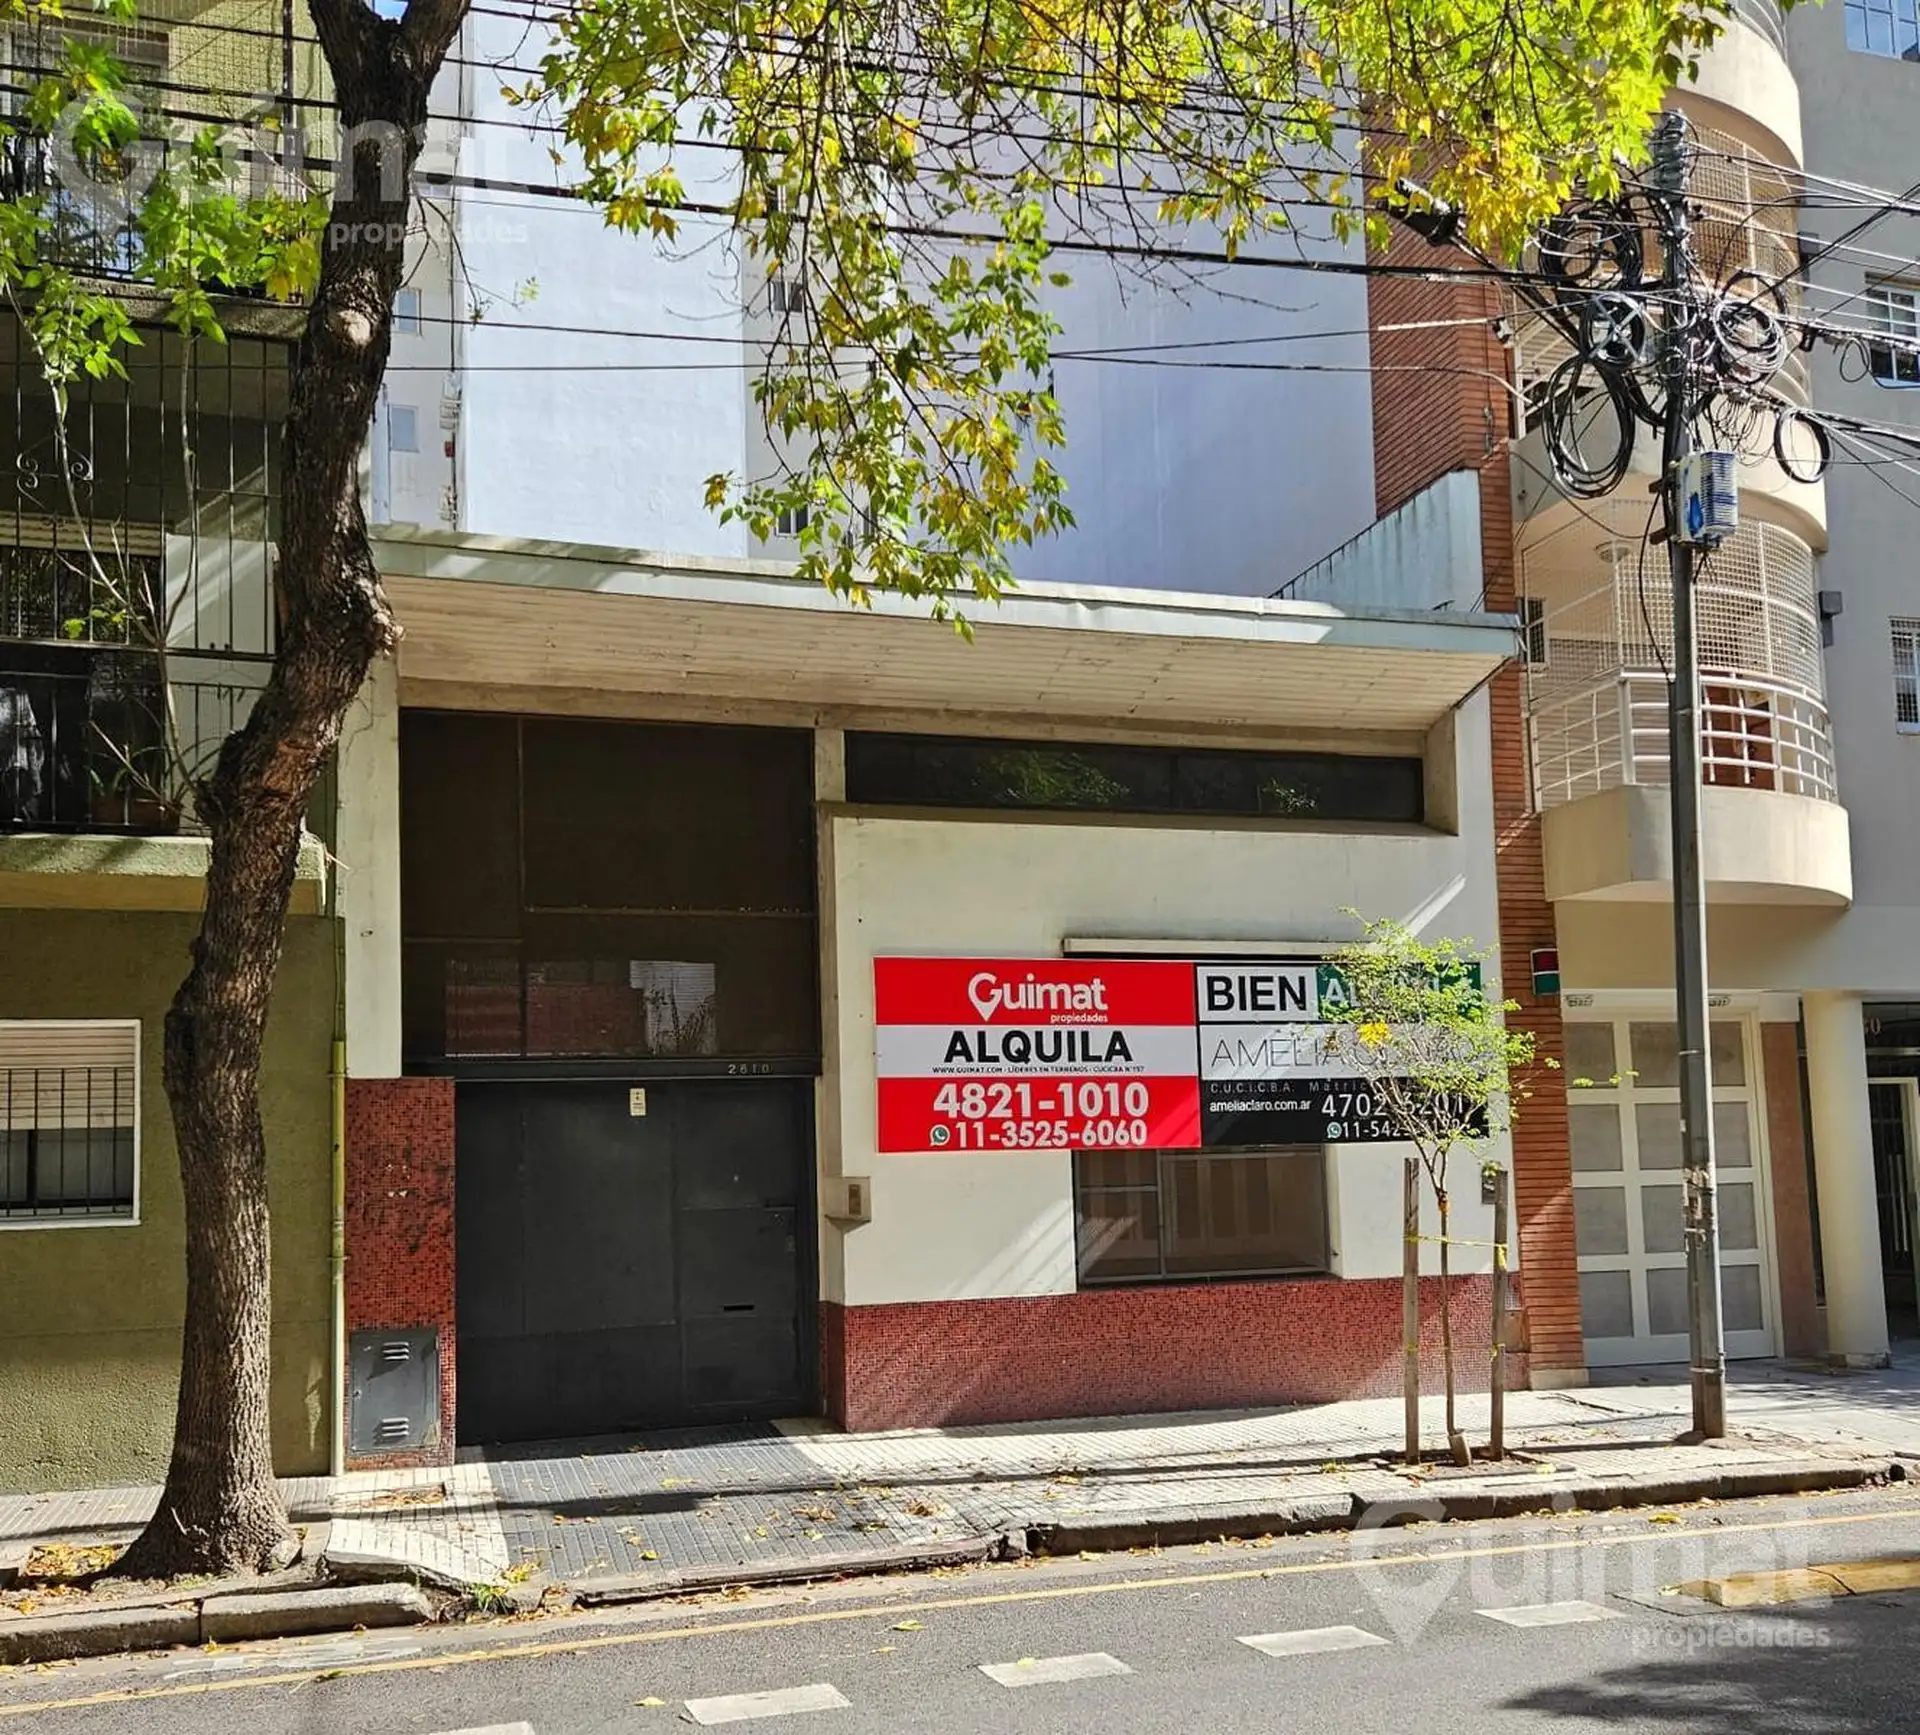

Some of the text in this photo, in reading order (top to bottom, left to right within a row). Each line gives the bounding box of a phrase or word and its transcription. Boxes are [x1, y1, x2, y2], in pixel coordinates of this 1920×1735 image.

[968, 972, 1109, 1021] Guimat
[1206, 975, 1307, 1012] BIEN
[1050, 1012, 1109, 1023] propiedades
[944, 1030, 1133, 1064] ALQUILA
[933, 1081, 1149, 1119] 4821-1010
[1209, 1099, 1312, 1113] ameliaclaro.com.ar
[955, 1119, 1148, 1148] 11-3525-6060
